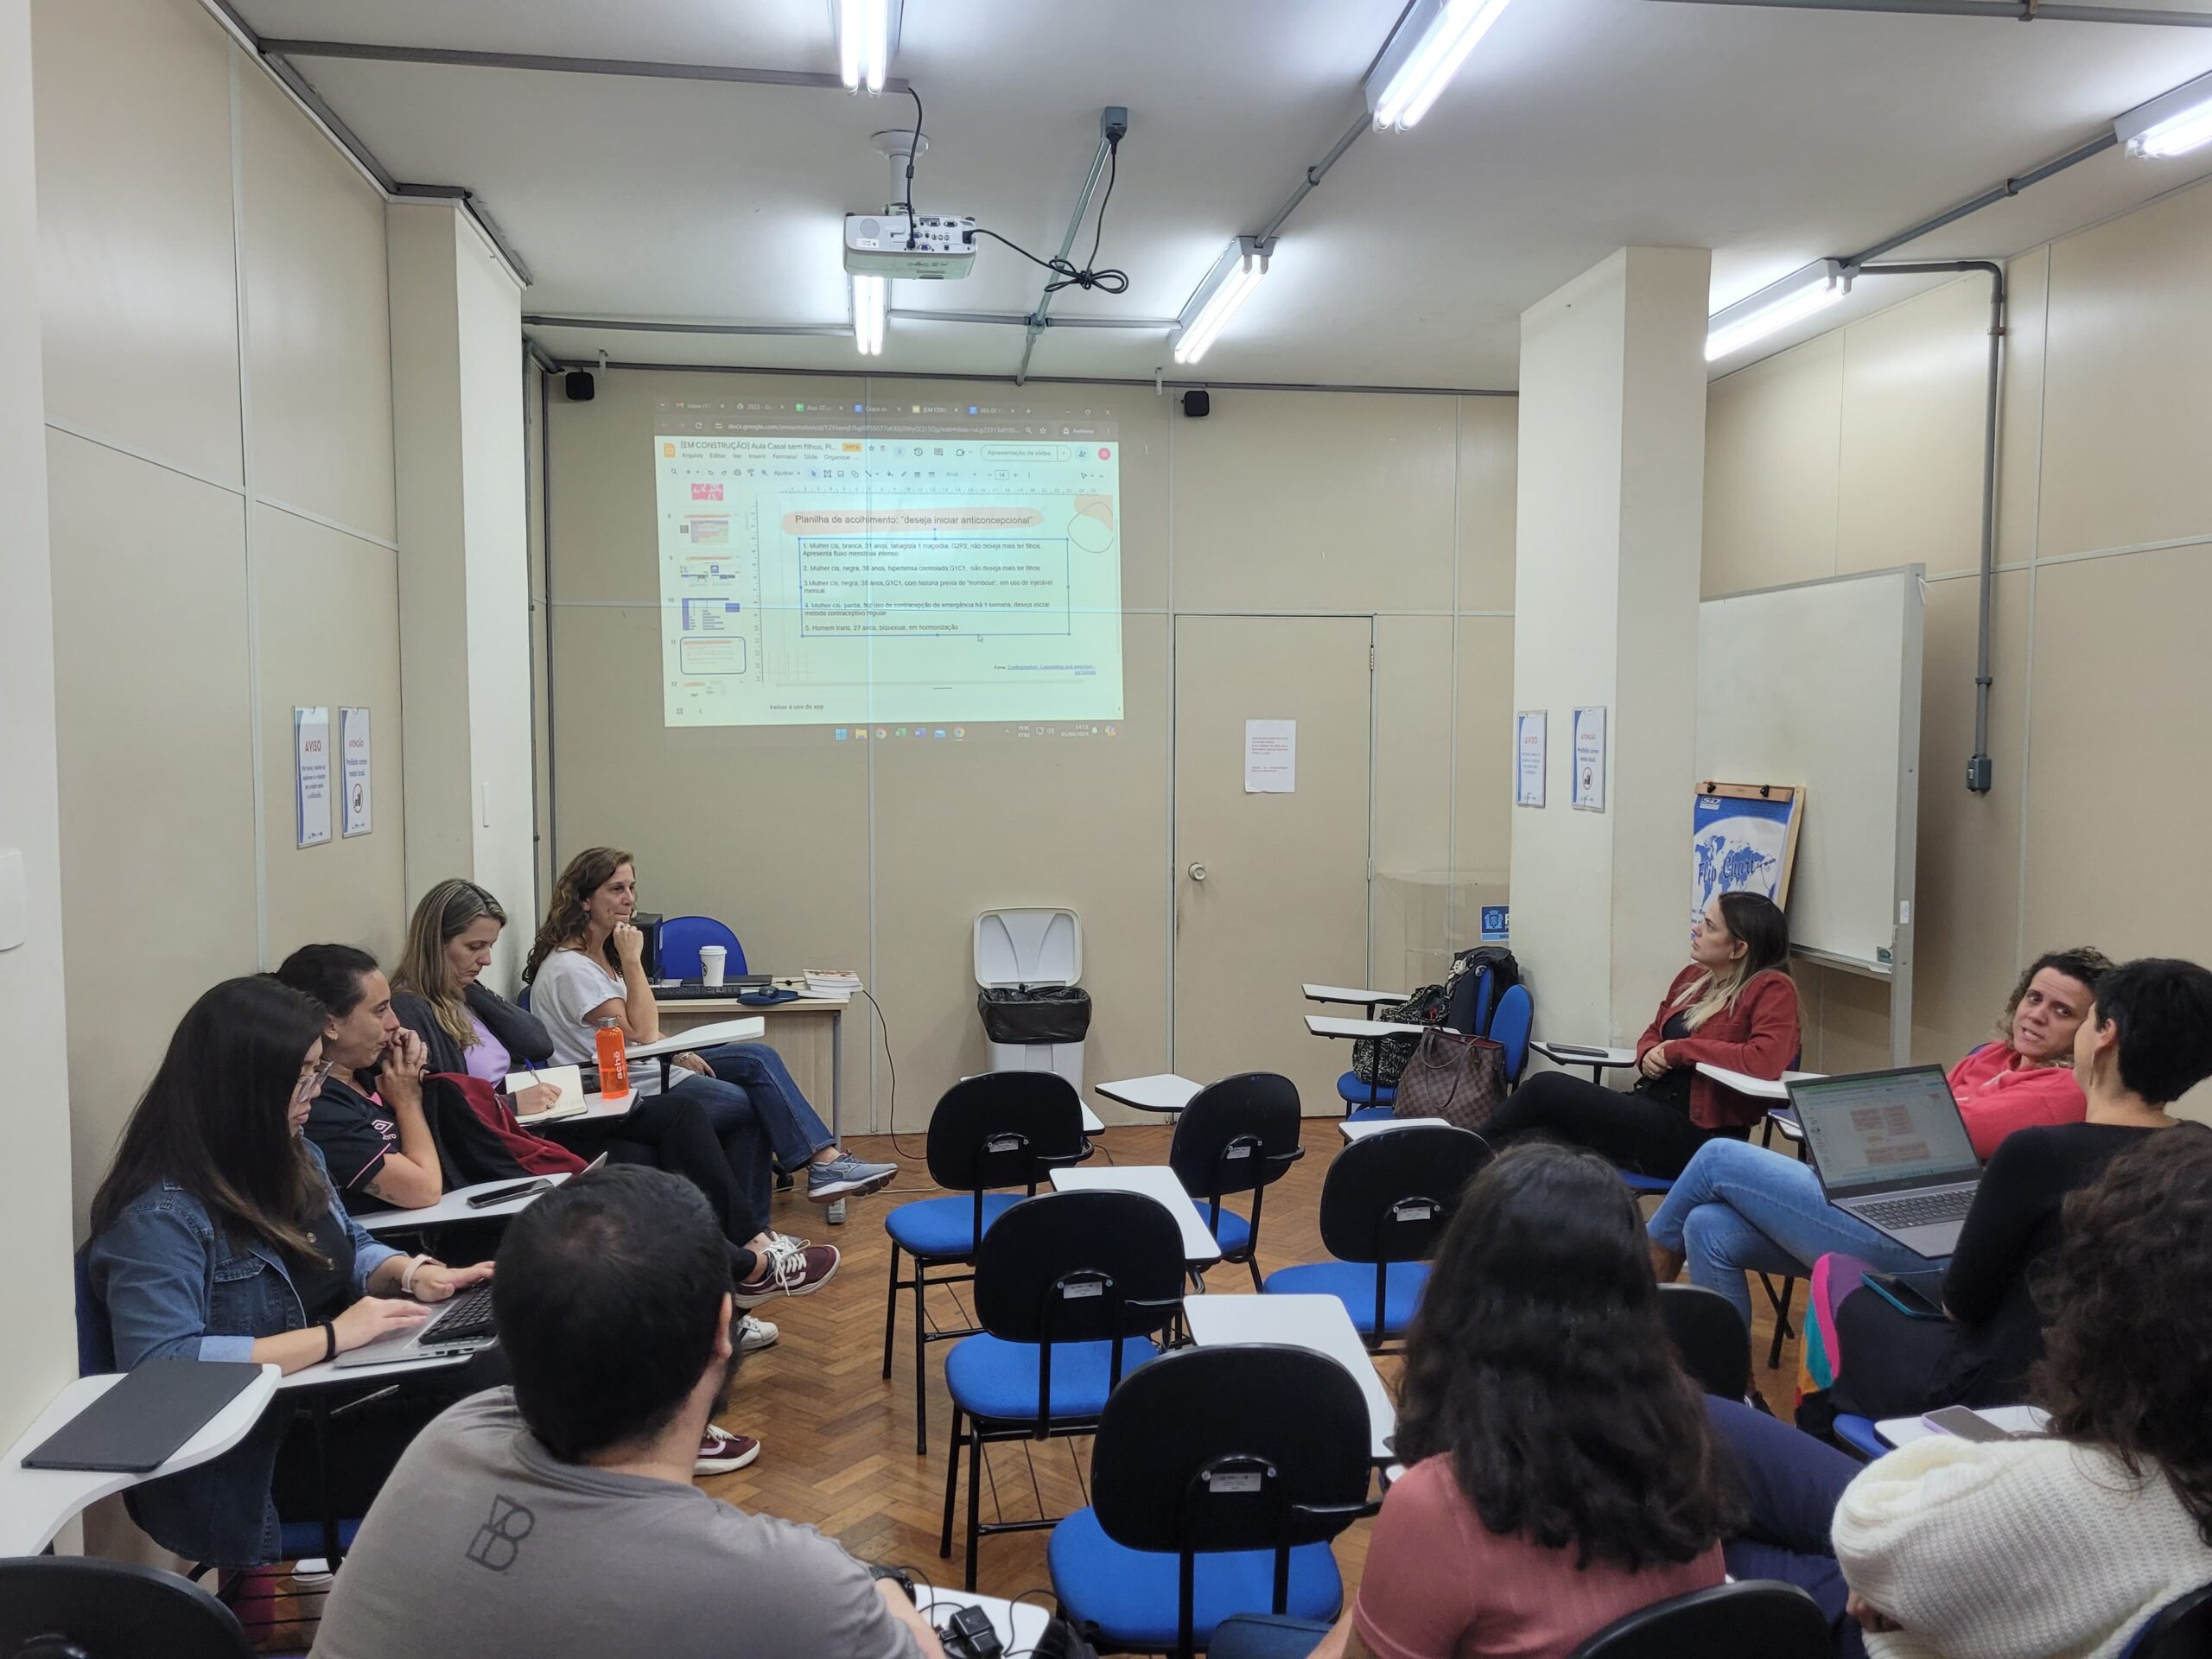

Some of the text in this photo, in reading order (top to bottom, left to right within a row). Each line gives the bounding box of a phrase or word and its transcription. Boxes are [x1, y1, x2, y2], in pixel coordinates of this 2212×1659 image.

[681, 441, 695, 449] [EM
[696, 441, 750, 450] CONSTRUÇÃO]
[795, 515, 830, 524] Planilha
[831, 515, 842, 524] de
[900, 516, 931, 525] "deseja
[934, 516, 959, 524] iniciar
[961, 516, 1033, 525] anticoncepcional"
[305, 740, 322, 752] AVISO
[1698, 853, 1755, 886] Flip Chart
